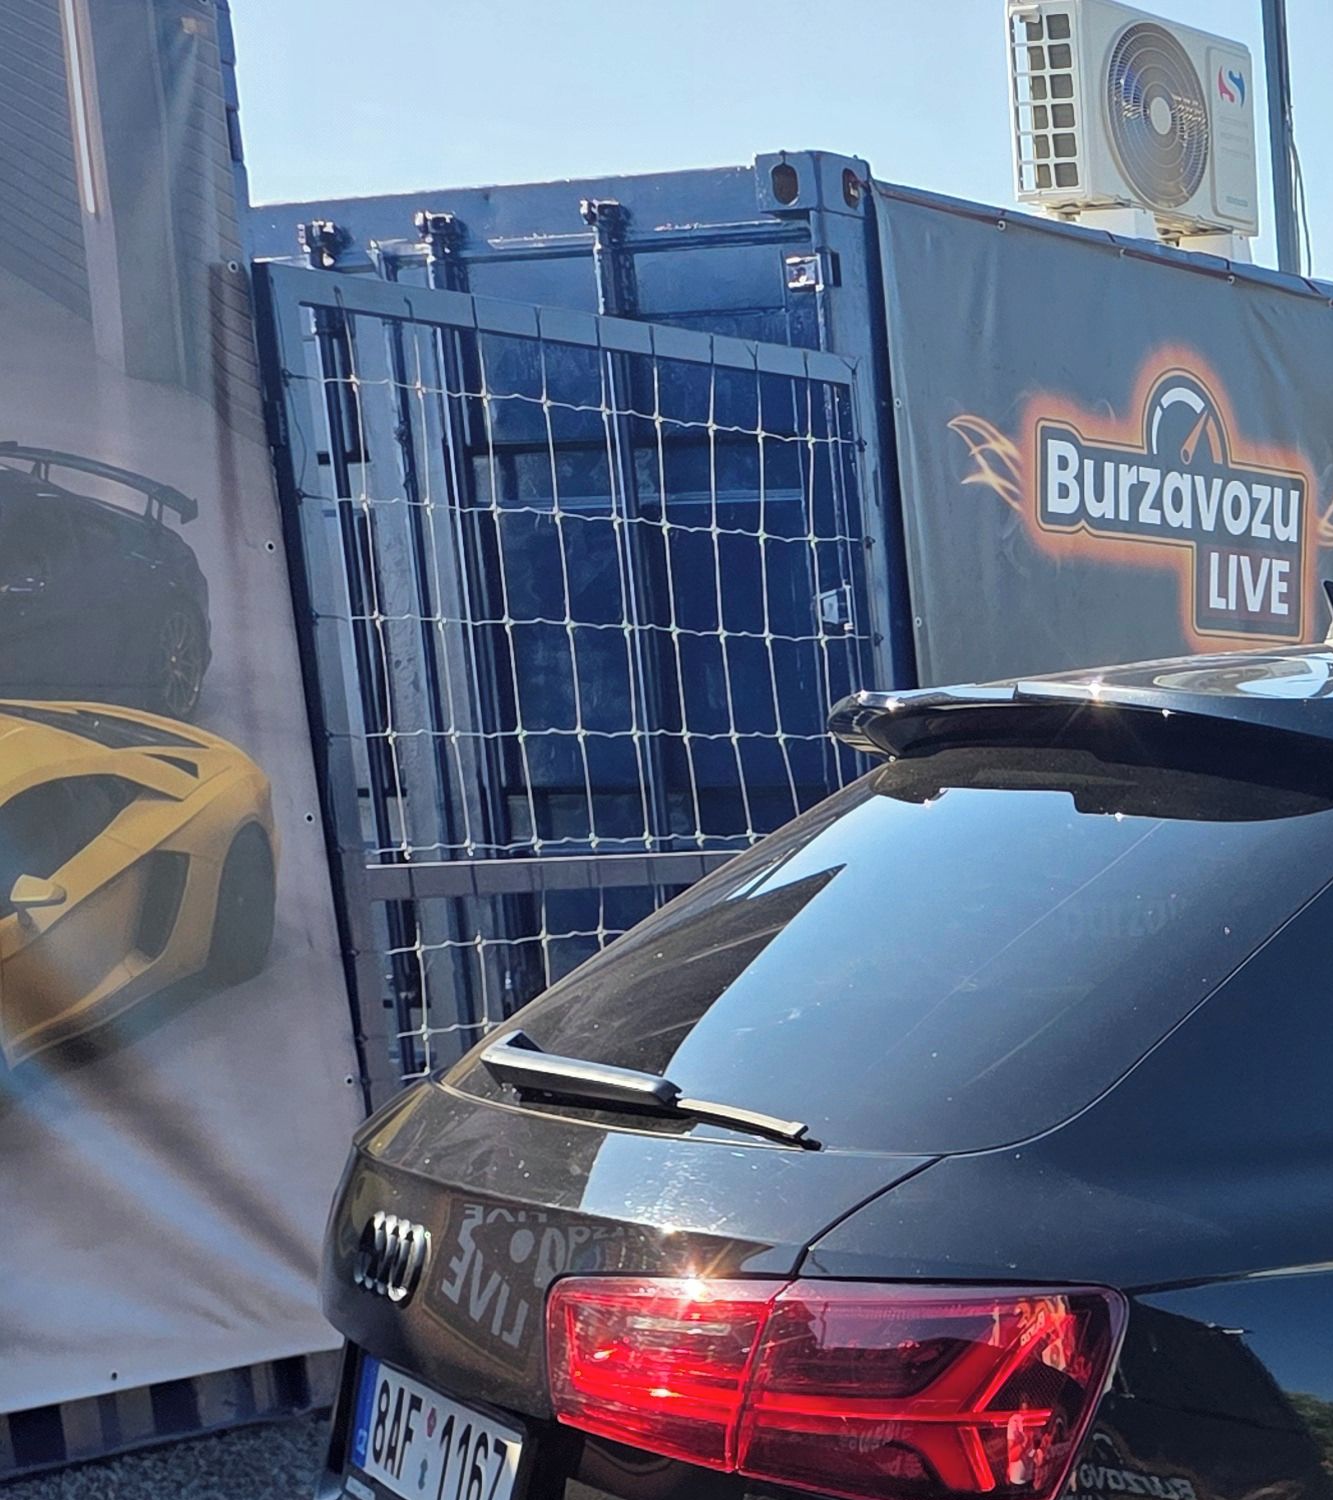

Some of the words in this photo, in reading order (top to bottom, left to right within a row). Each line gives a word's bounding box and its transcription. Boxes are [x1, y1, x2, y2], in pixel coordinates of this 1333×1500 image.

[1047, 438, 1300, 543] Burzavozu
[1209, 552, 1290, 615] LIVE
[372, 1378, 423, 1481] 8AF
